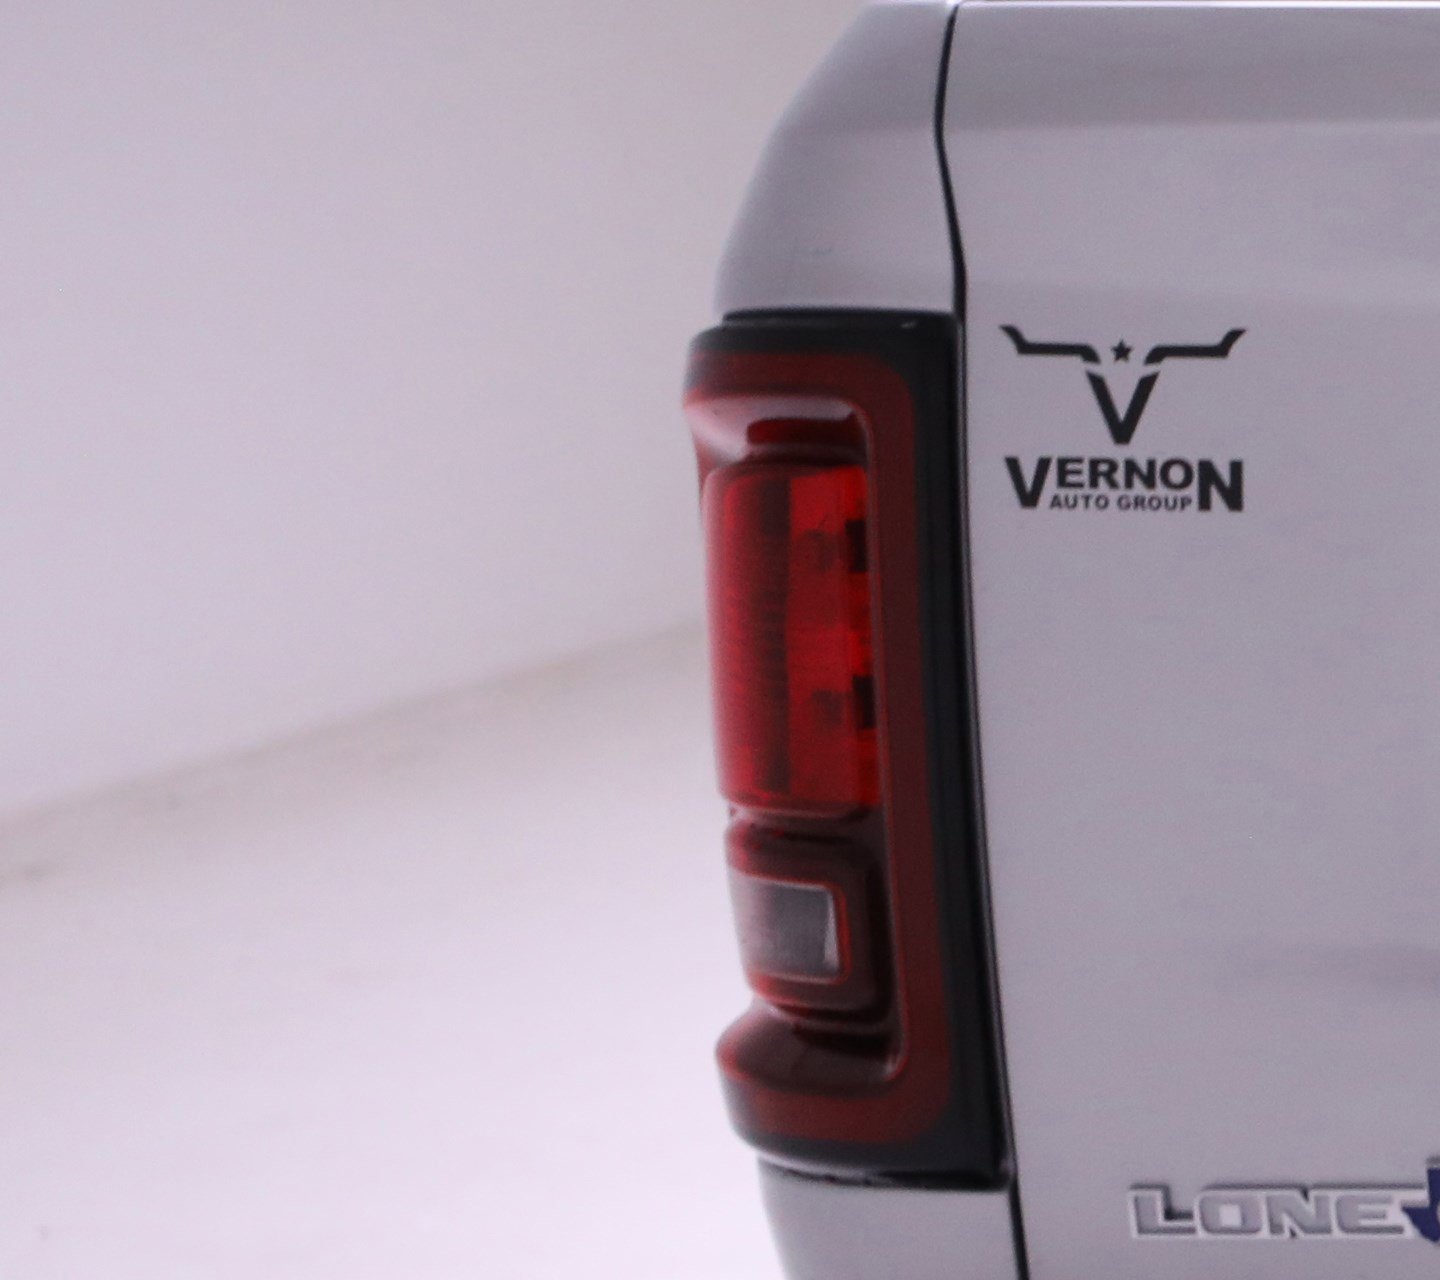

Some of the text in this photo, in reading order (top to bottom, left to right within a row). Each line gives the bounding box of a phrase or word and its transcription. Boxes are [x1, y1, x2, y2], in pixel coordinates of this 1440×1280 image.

[1004, 456, 1245, 512] VERNON
[1050, 494, 1193, 512] AUTO GROUP
[1127, 1183, 1410, 1240] LONE
